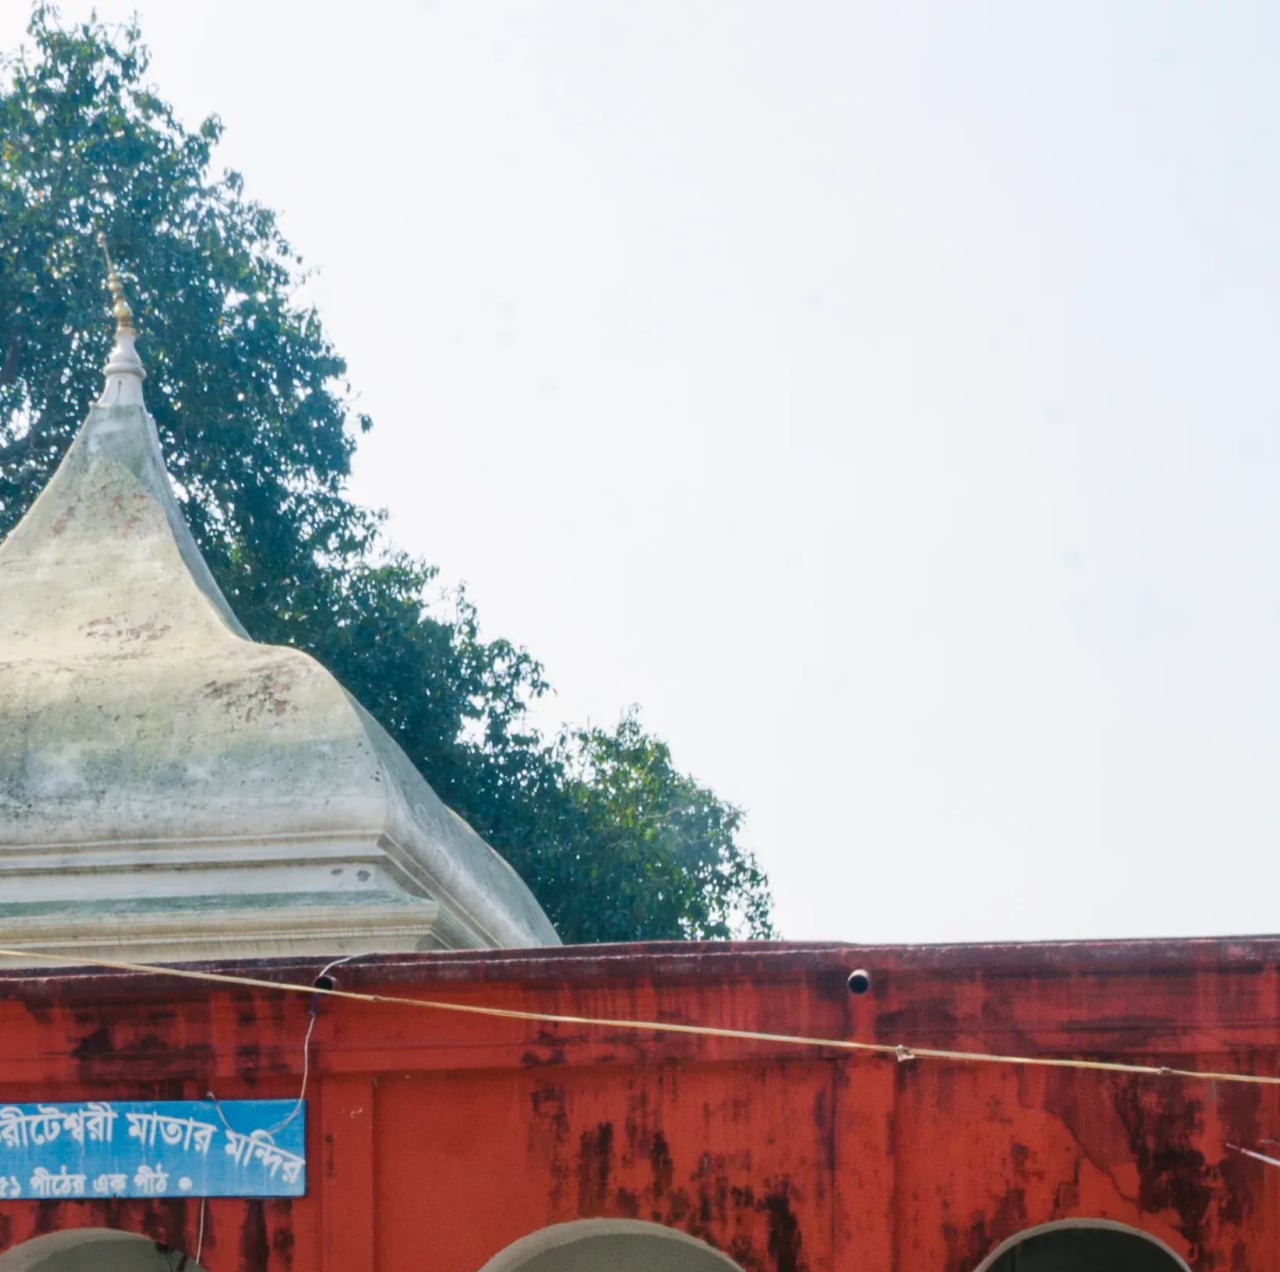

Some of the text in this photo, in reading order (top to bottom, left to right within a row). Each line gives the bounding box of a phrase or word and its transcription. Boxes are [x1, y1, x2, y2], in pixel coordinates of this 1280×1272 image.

[125, 1111, 218, 1155] মাতার
[224, 1129, 306, 1184] মন্দির
[30, 1165, 87, 1196] পীঠের
[92, 1174, 128, 1194] এক
